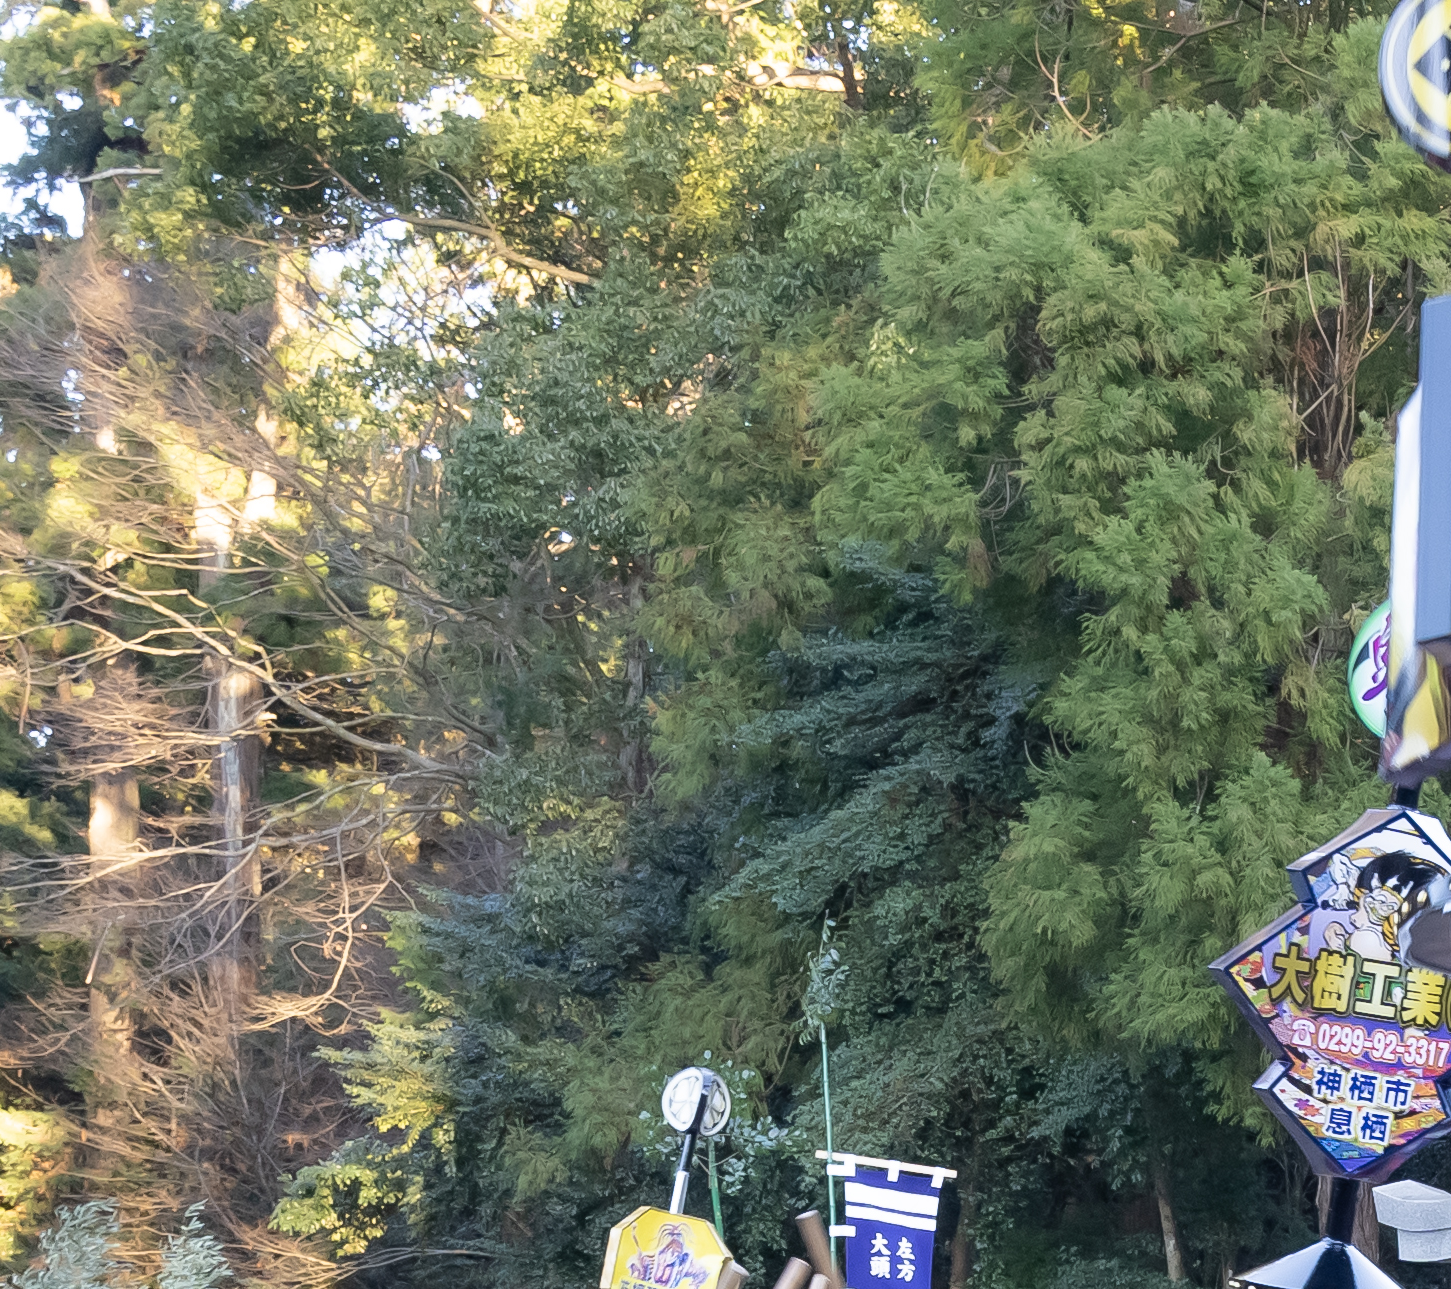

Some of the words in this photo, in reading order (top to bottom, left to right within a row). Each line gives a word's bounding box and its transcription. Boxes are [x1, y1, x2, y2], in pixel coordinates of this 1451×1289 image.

[1316, 1022, 1451, 1068] 0299-92-3317
[1313, 1065, 1414, 1107] 神栖市
[1324, 1108, 1392, 1146] 息栖
[870, 1233, 892, 1279] 大頭
[896, 1237, 916, 1282] 左方
